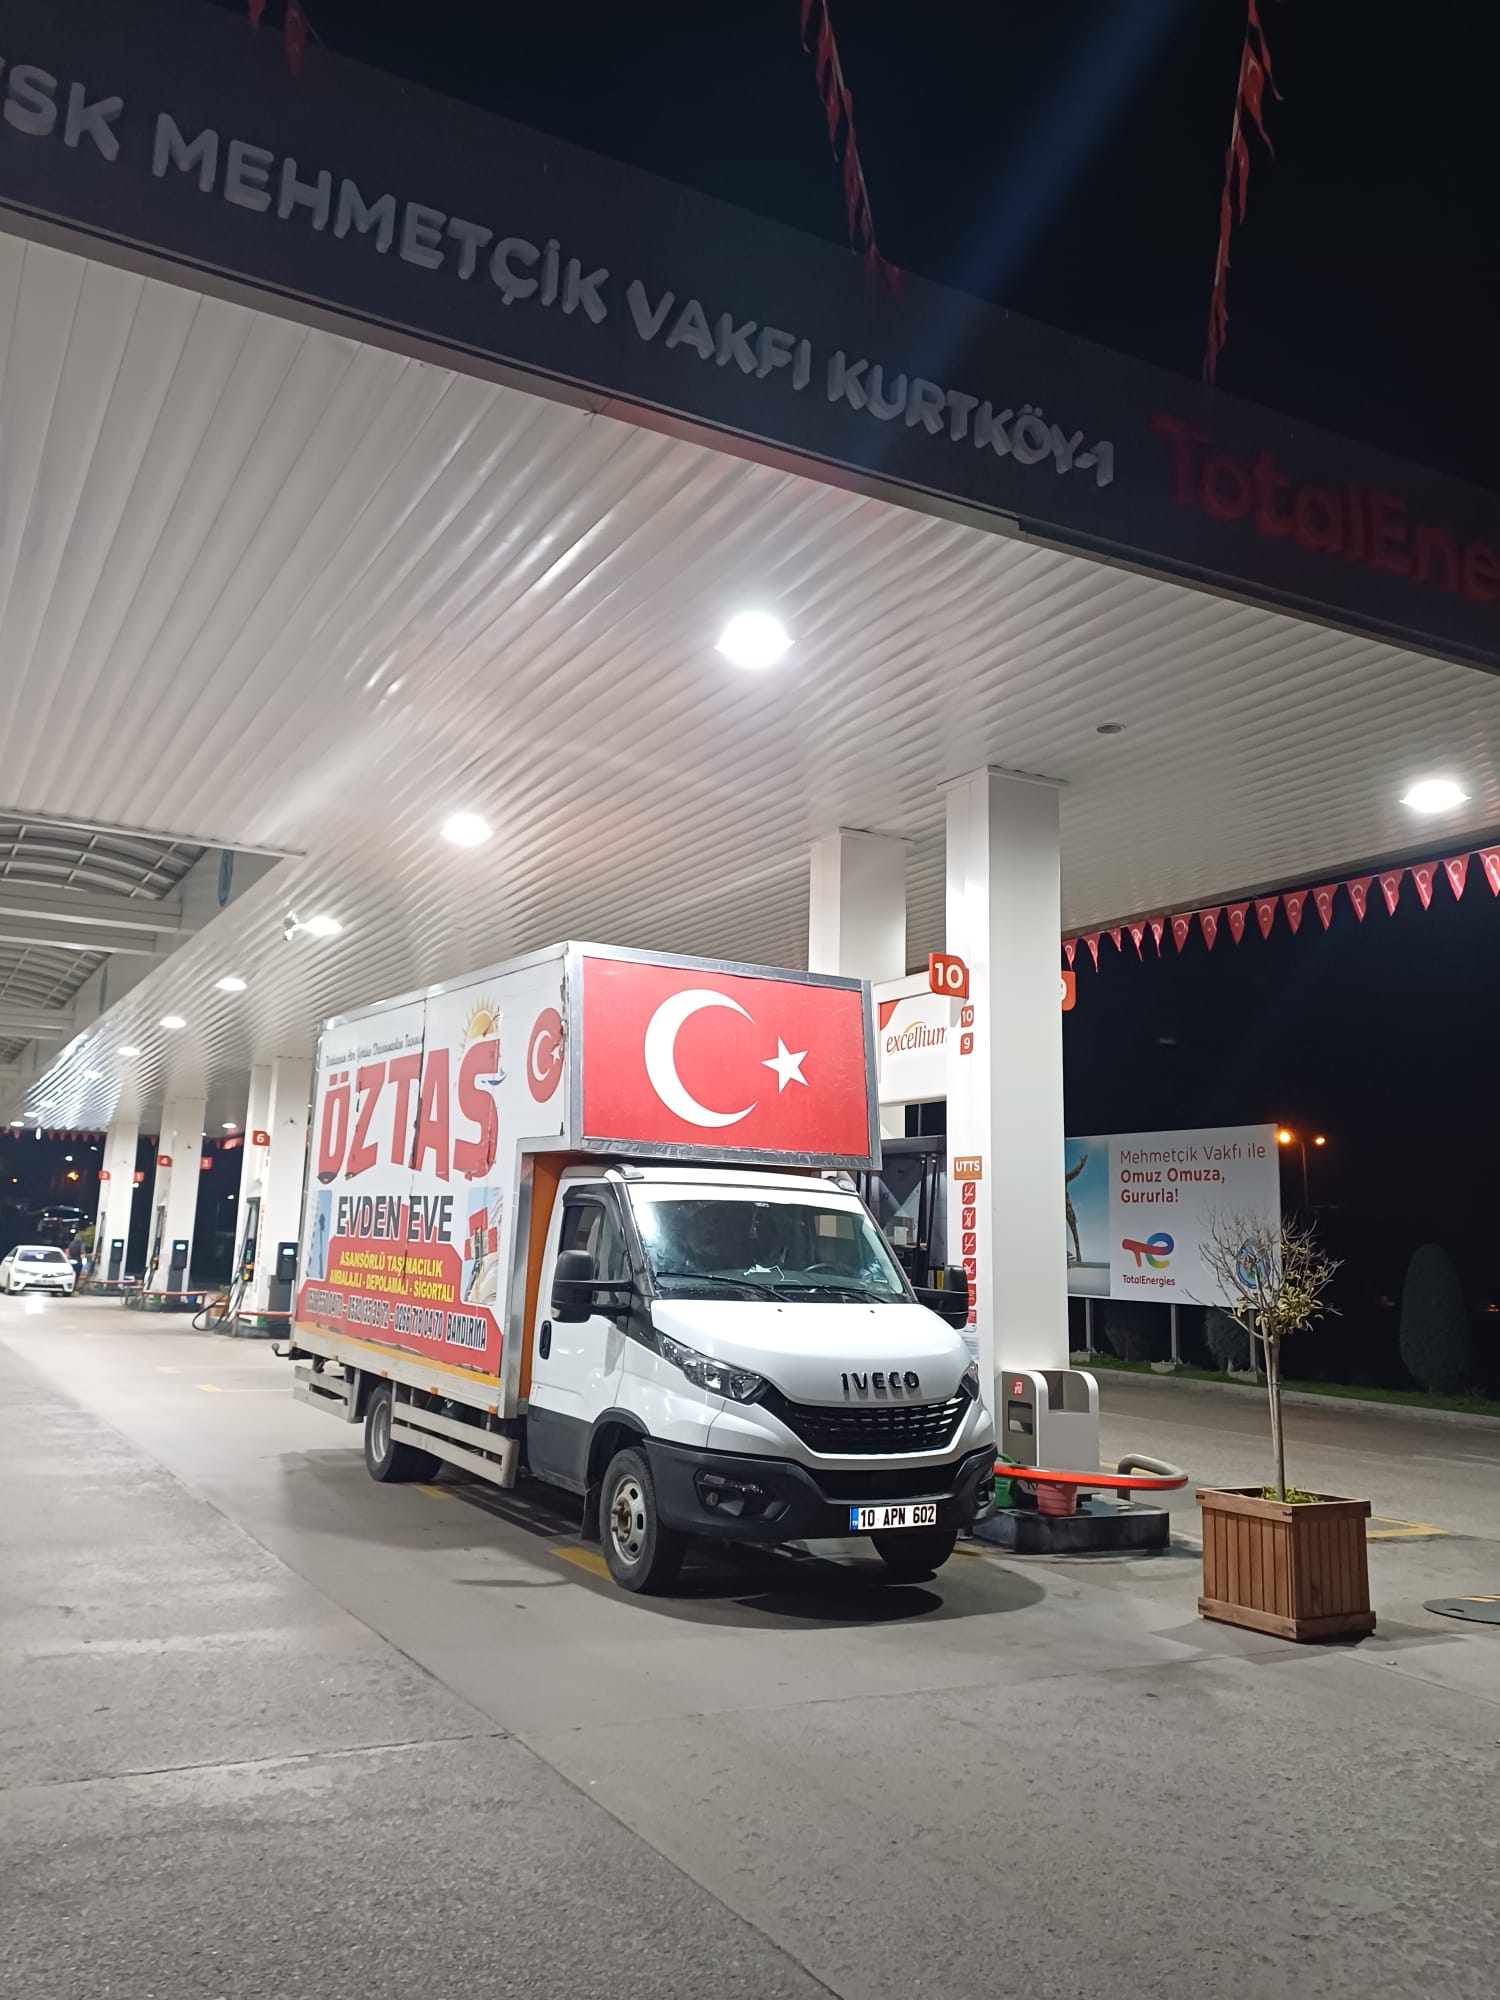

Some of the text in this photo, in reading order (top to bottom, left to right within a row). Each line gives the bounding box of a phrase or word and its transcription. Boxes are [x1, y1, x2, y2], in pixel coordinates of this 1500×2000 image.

[0, 56, 124, 161] SK
[152, 112, 609, 324] MEHMETÇİK
[626, 279, 811, 391] VAKFI
[934, 962, 964, 989] 10
[961, 1009, 973, 1022] 10
[963, 1039, 970, 1050] 9
[256, 1133, 265, 1143] 6
[1120, 1142, 1266, 1164] Mehmetçik Vakfı ile
[956, 1160, 980, 1173] UTTS
[1120, 1167, 1225, 1184] Omuz Omuza,
[1121, 1188, 1178, 1203] Gururla!
[336, 1195, 454, 1242] EVDEN EVE
[339, 1250, 444, 1278] ASANSÖRLÜ TAŞIMACILIK
[414, 1278, 455, 1303] SİGORTALI
[1122, 1274, 1176, 1288] TotalEnergies
[445, 1312, 487, 1351] BANDIRMA
[841, 1371, 920, 1391] IVECO
[861, 1509, 875, 1528] 10
[883, 1507, 906, 1527] APN
[912, 1505, 935, 1524] 602
